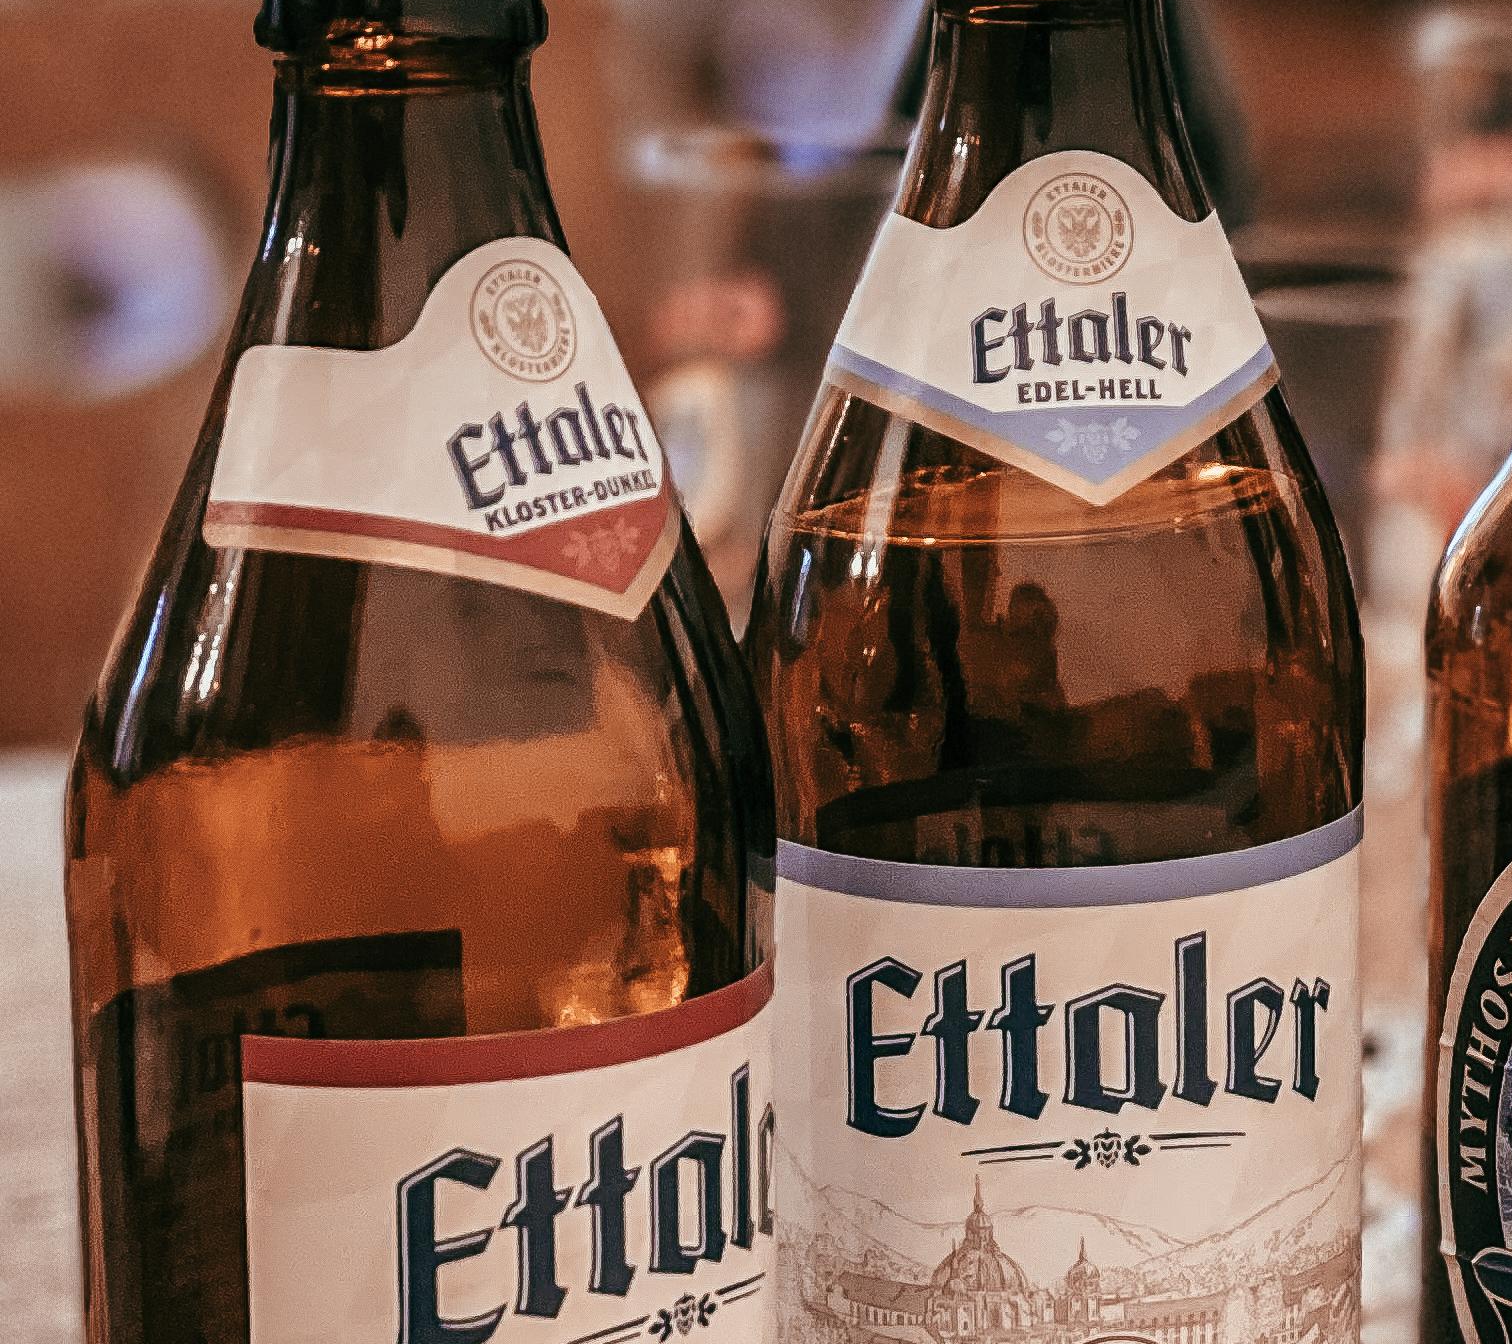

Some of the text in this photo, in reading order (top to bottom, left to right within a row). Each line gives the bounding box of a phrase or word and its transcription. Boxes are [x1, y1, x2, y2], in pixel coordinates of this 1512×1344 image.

[971, 291, 1192, 385] Ettaler
[1017, 378, 1162, 405] EDEL-HELL
[446, 381, 650, 511] Ettaler
[845, 930, 1331, 1138] Ettaler
